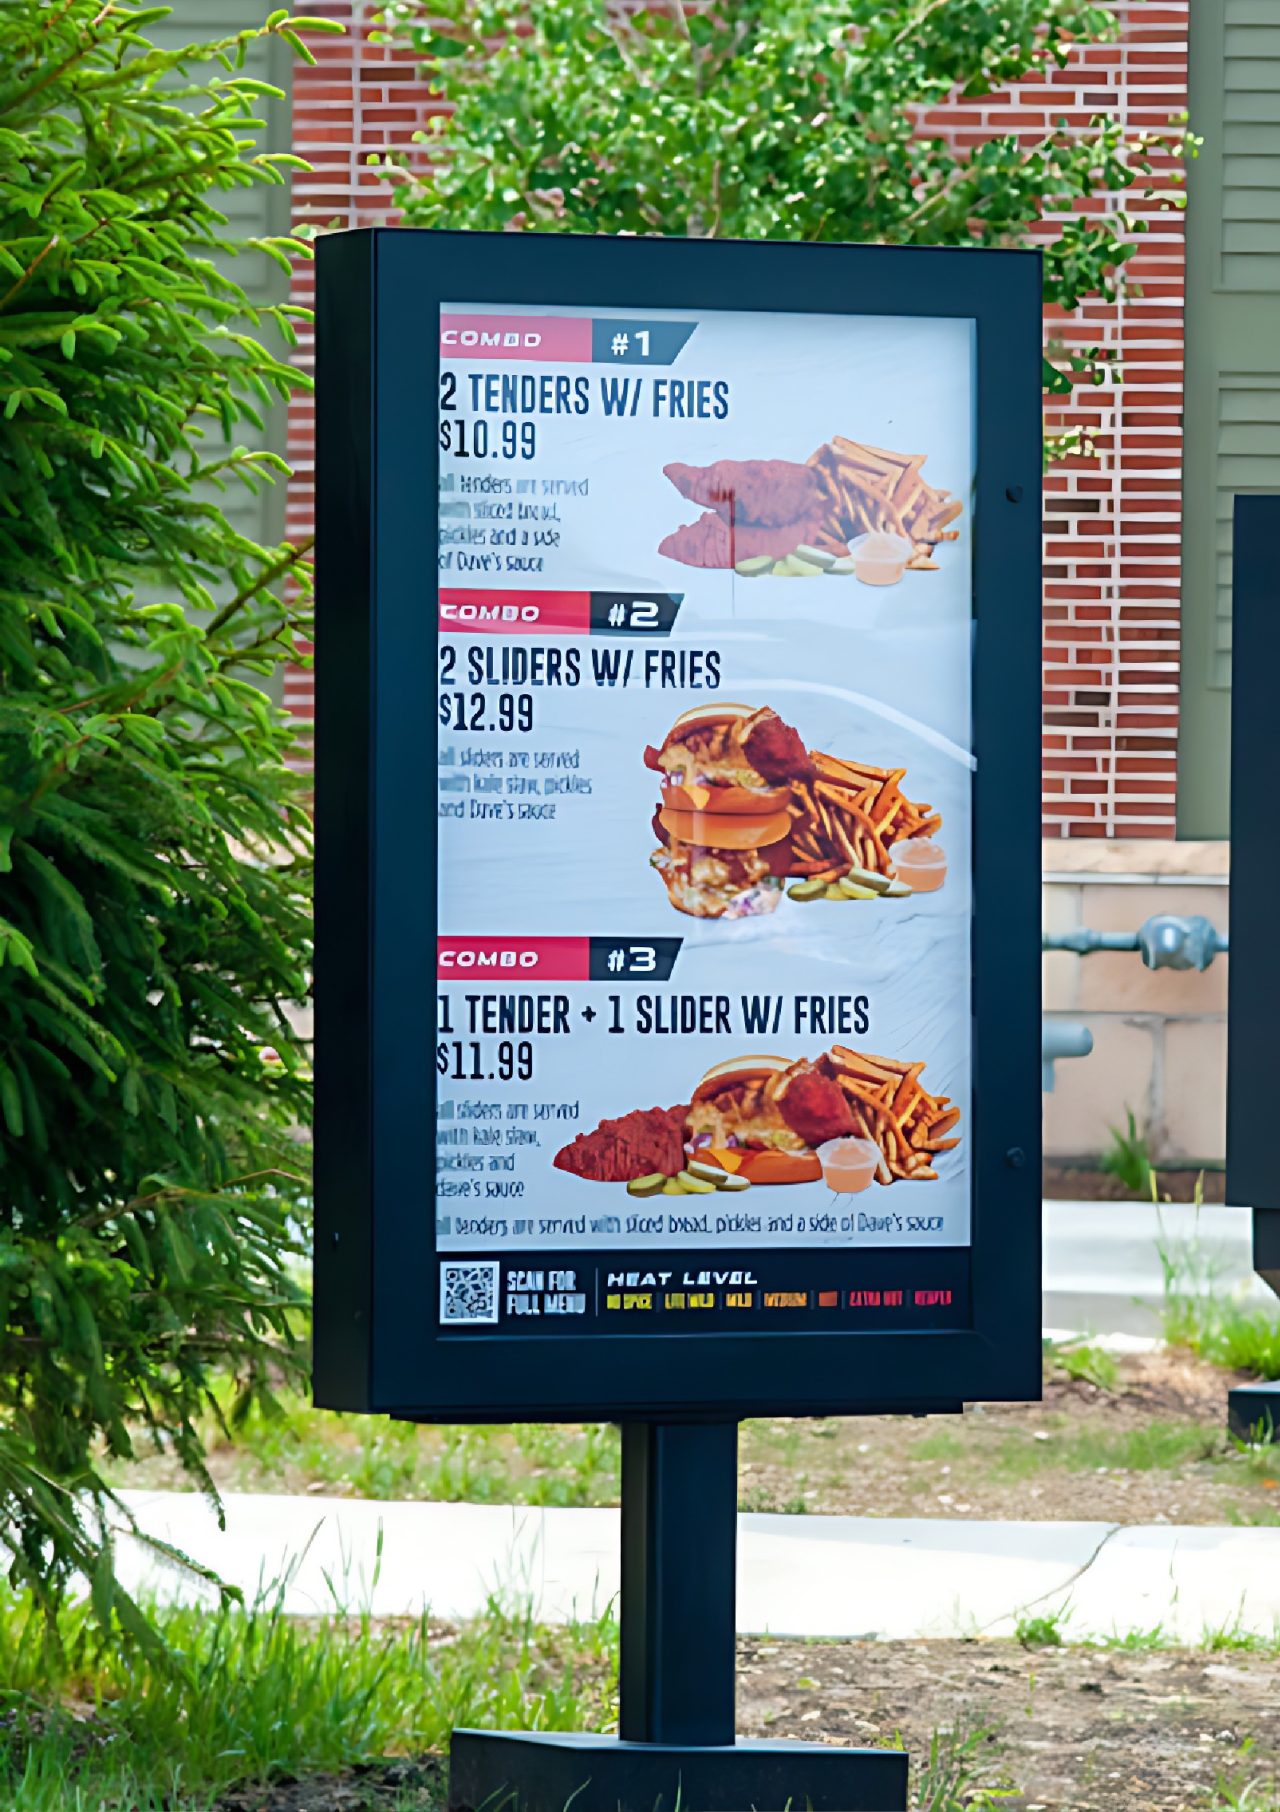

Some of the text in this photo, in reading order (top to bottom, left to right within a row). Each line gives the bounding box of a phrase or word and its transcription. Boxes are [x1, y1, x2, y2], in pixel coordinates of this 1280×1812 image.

[441, 330, 650, 356] COMBO #1
[440, 372, 729, 419] 2 TENDERS W/ FRIES
[440, 420, 536, 459] $10.99
[440, 601, 659, 627] COMBO #2
[440, 646, 721, 688] 2 SLIDERS W/ FRIES
[439, 693, 533, 732] $12.99
[439, 947, 656, 971] COMBO #3
[438, 995, 869, 1034] 1 TENDER + 1 SLIDER W/ FRIES
[437, 1041, 533, 1080] $11.99
[607, 1271, 672, 1287] HEAT
